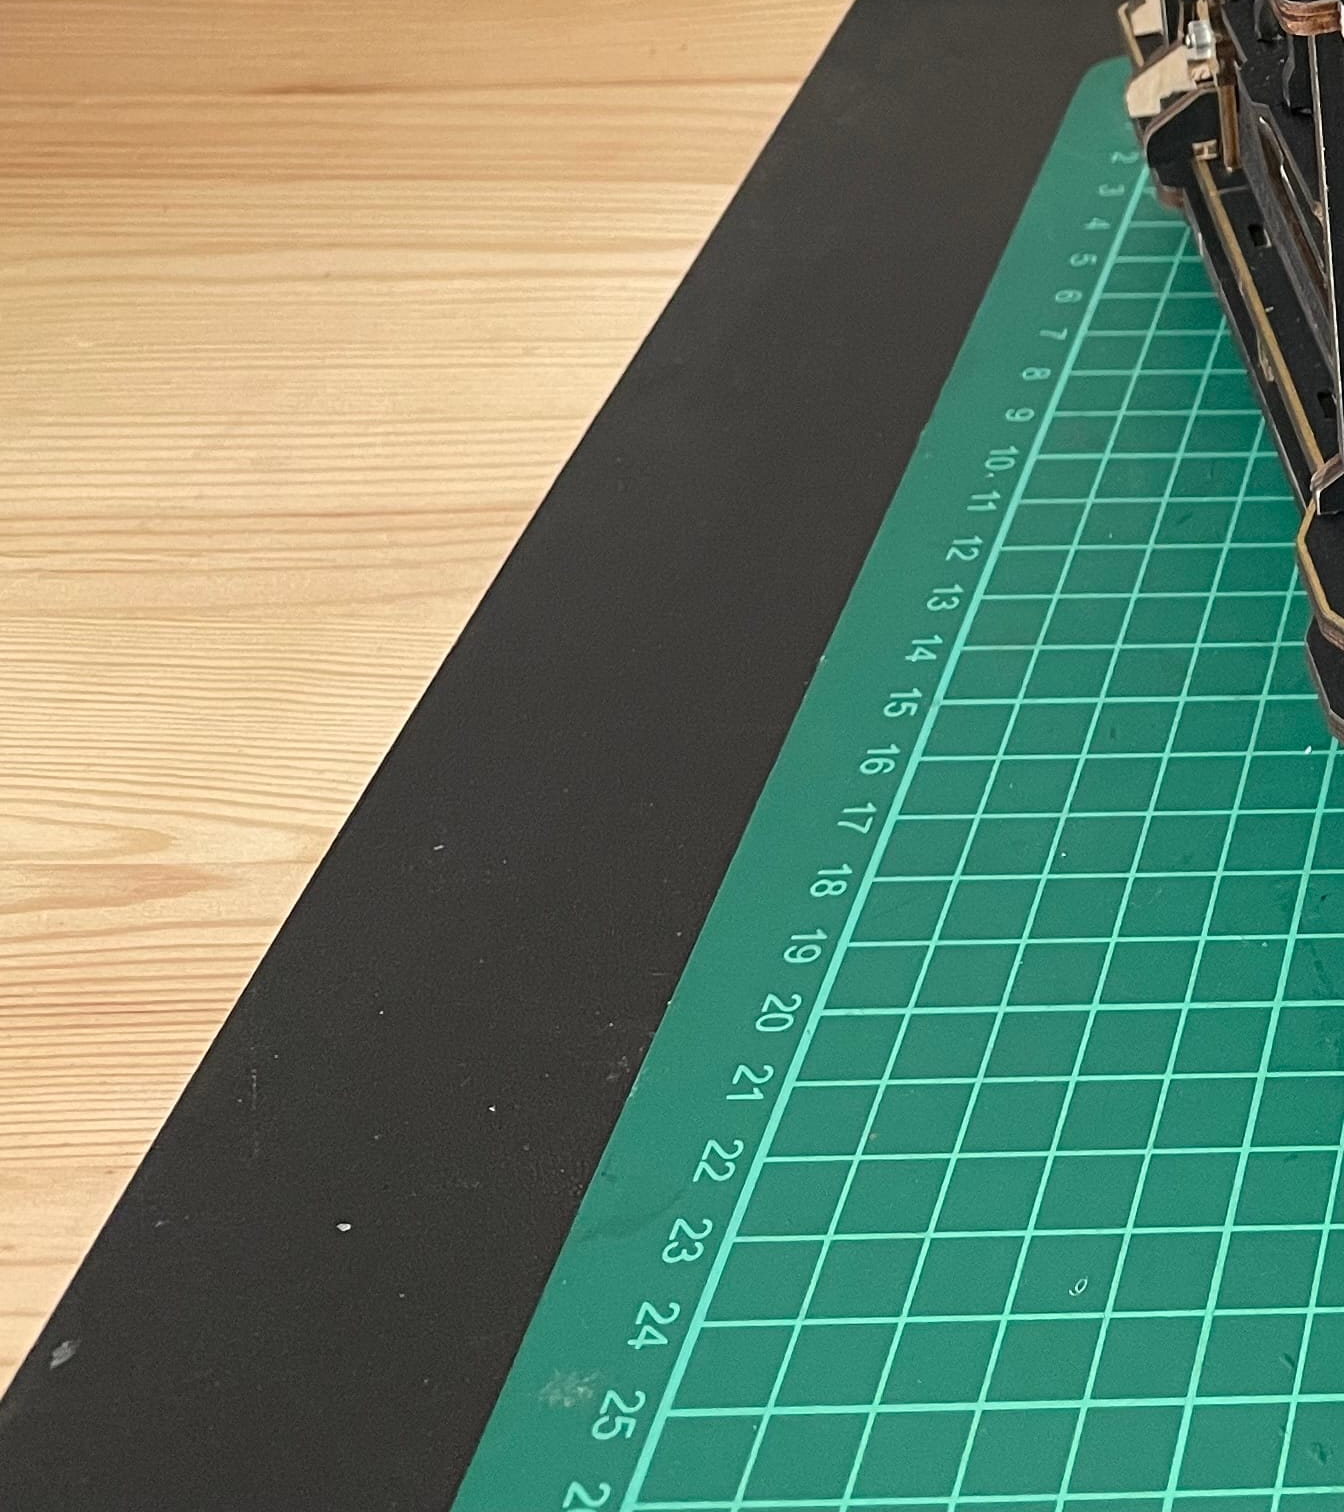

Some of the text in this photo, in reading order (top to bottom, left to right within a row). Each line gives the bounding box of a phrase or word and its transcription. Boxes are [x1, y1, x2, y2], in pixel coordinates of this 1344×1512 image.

[1069, 253, 1098, 267] 5
[1054, 289, 1083, 303] 6
[1039, 327, 1068, 341] 7
[1021, 366, 1052, 381] 8
[1004, 407, 1035, 422] 9
[983, 445, 1020, 472] 10
[966, 490, 1001, 512] 11
[944, 535, 984, 562] 12
[926, 583, 965, 612] 13
[904, 634, 944, 663] 14
[882, 687, 923, 718] 15
[859, 743, 901, 775] 16
[836, 801, 878, 834] 17
[809, 863, 853, 898] 18
[783, 928, 828, 964] 19
[755, 993, 802, 1033] 20
[725, 1064, 775, 1101] 21
[692, 1139, 745, 1183] 22
[661, 1218, 714, 1264] 23
[626, 1301, 681, 1350] 24
[591, 1389, 646, 1441] 25
[562, 1481, 611, 1512] 2
